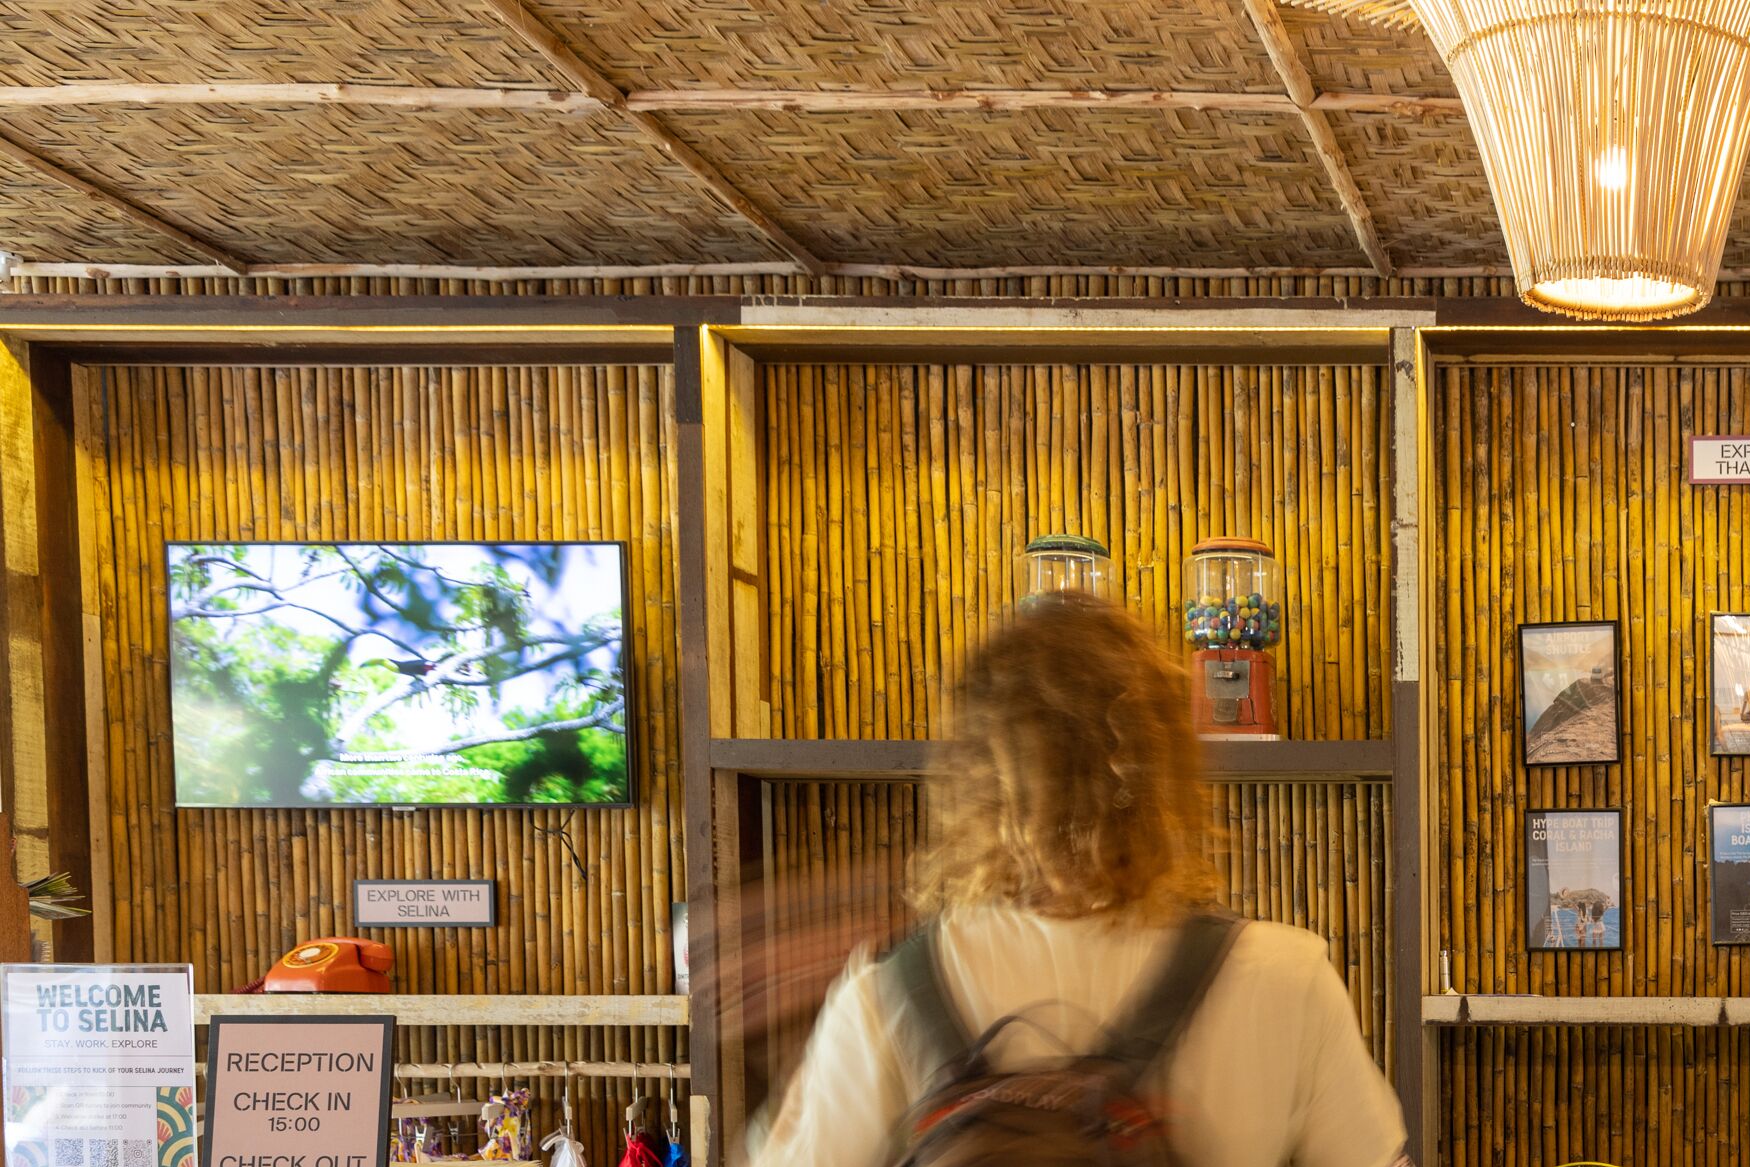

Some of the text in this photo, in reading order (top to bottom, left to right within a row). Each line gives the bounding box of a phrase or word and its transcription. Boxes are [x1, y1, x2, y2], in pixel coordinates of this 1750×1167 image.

[1532, 818, 1559, 829] HYPE
[1532, 830, 1566, 841] CORAL
[367, 889, 481, 902] EXPLORE WITH
[397, 905, 450, 917] SELINA
[36, 984, 162, 1008] WELCOME
[36, 1009, 168, 1032] TO SELINA
[75, 1040, 108, 1048] WORK.
[111, 1040, 158, 1048] EXPLORE
[227, 1052, 374, 1073] RECEPTION
[233, 1091, 351, 1112] CHECK IN
[267, 1116, 320, 1132] 15:00
